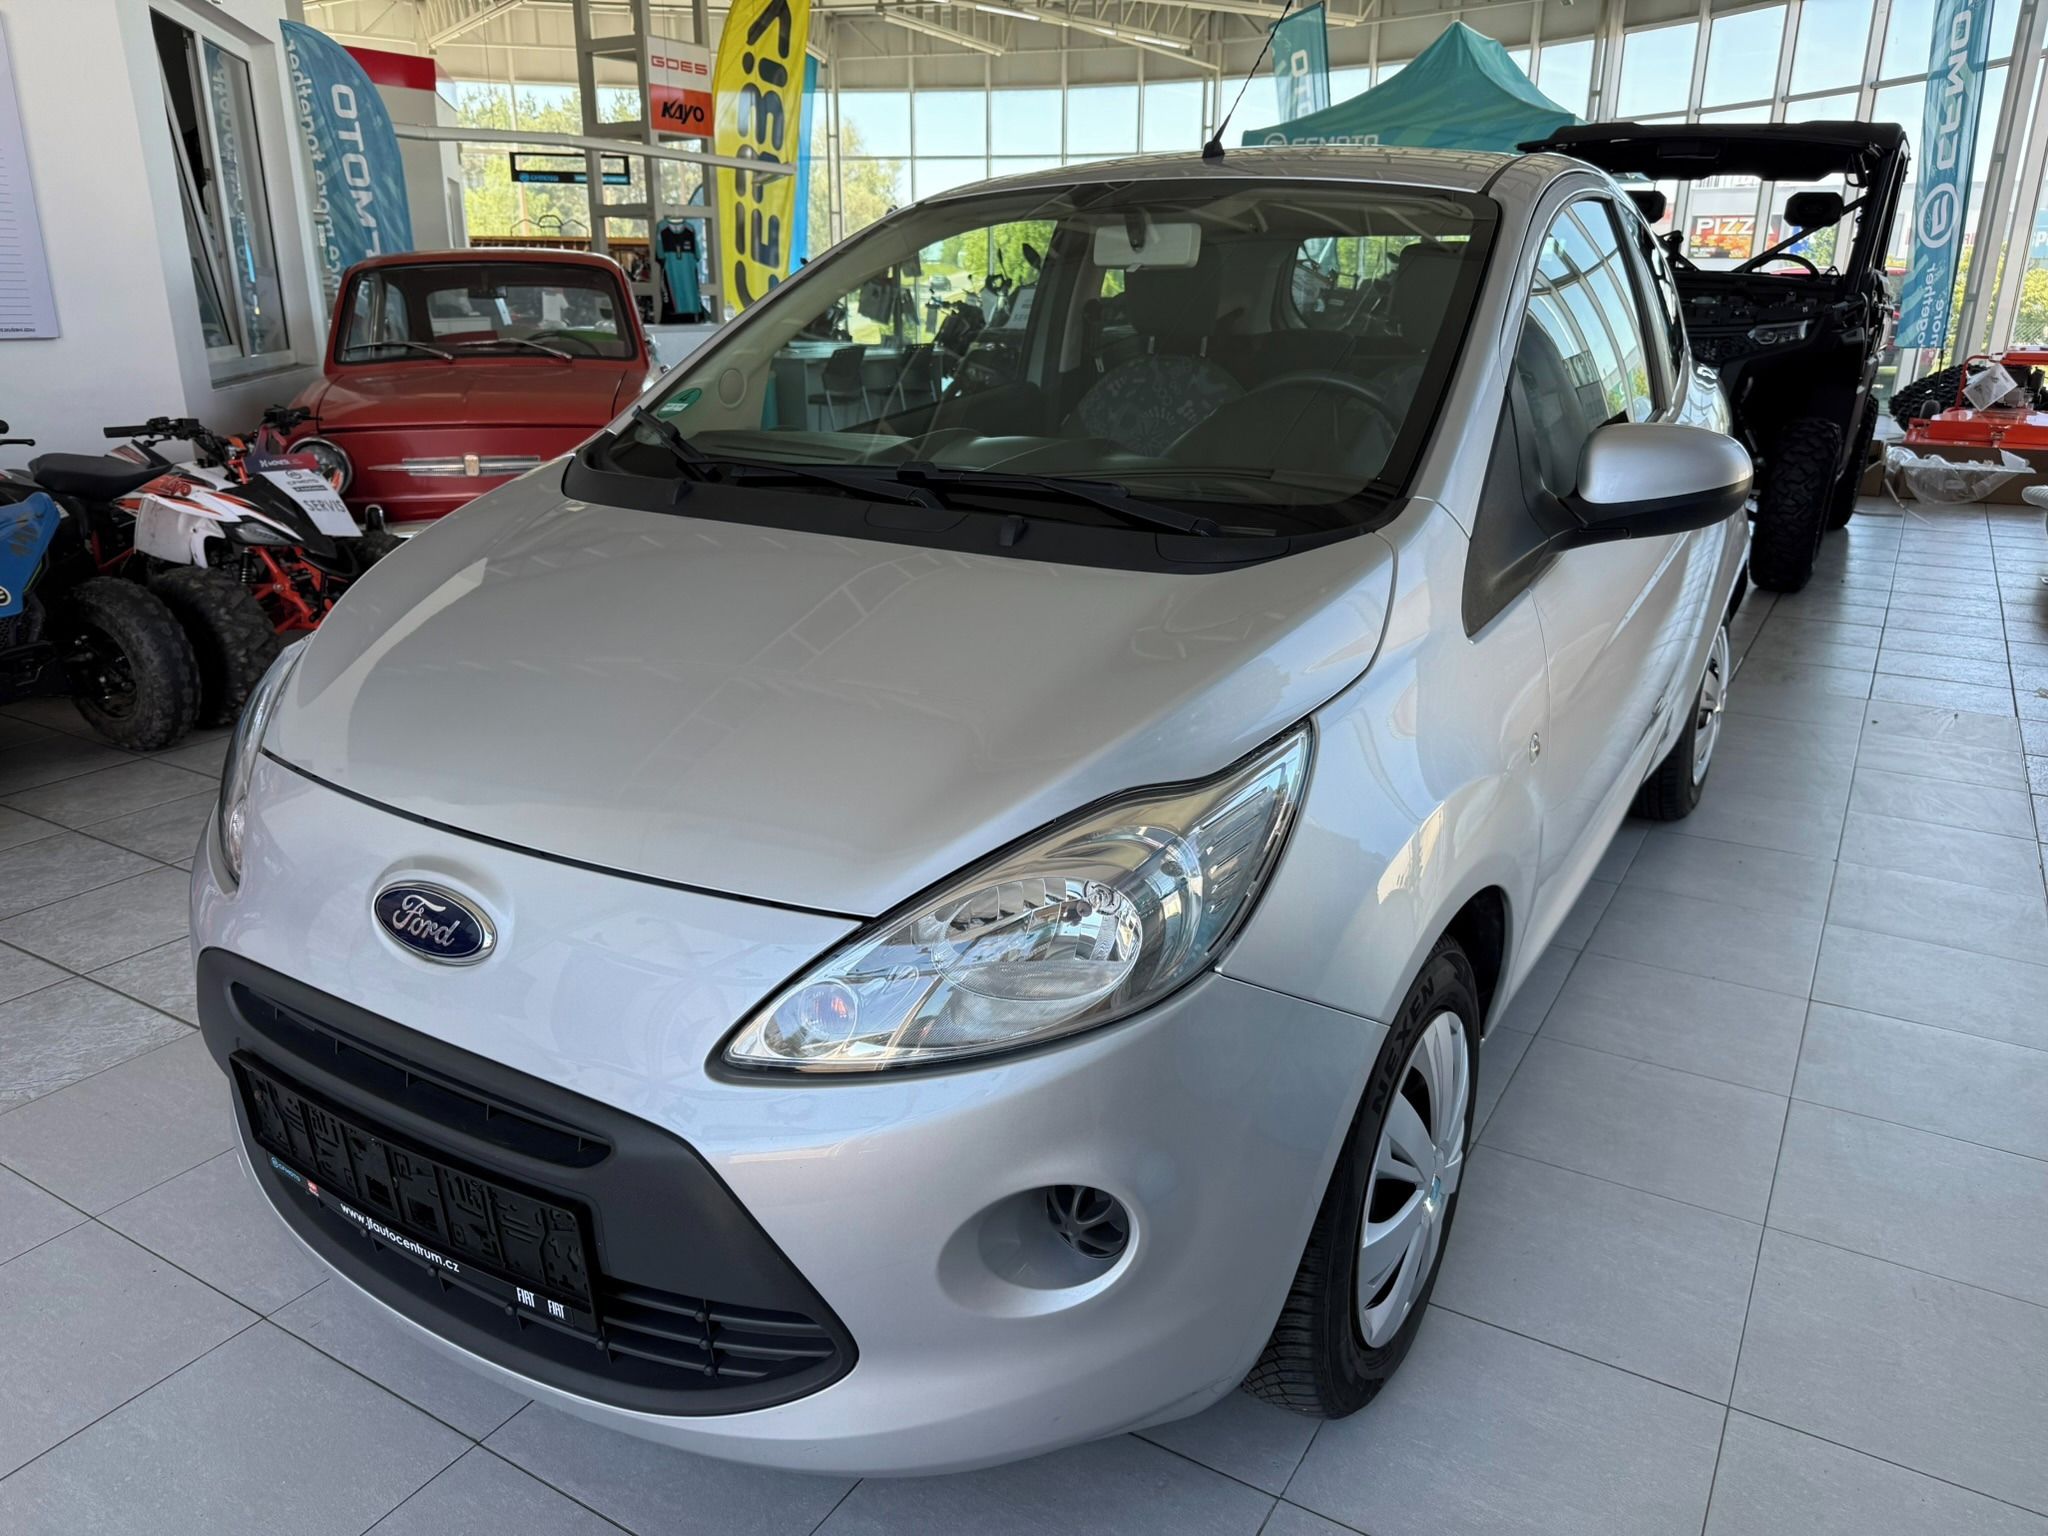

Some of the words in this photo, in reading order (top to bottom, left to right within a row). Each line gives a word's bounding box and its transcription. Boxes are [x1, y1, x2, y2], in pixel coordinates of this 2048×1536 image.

[651, 55, 708, 76] GOES
[303, 499, 346, 513] SERVIS
[392, 894, 461, 947] Ford
[1371, 976, 1435, 1115] NEXEN
[340, 1203, 460, 1273] www.jfautocentrum.cz
[516, 1286, 536, 1309] FIAT
[547, 1299, 566, 1320] FIAT
